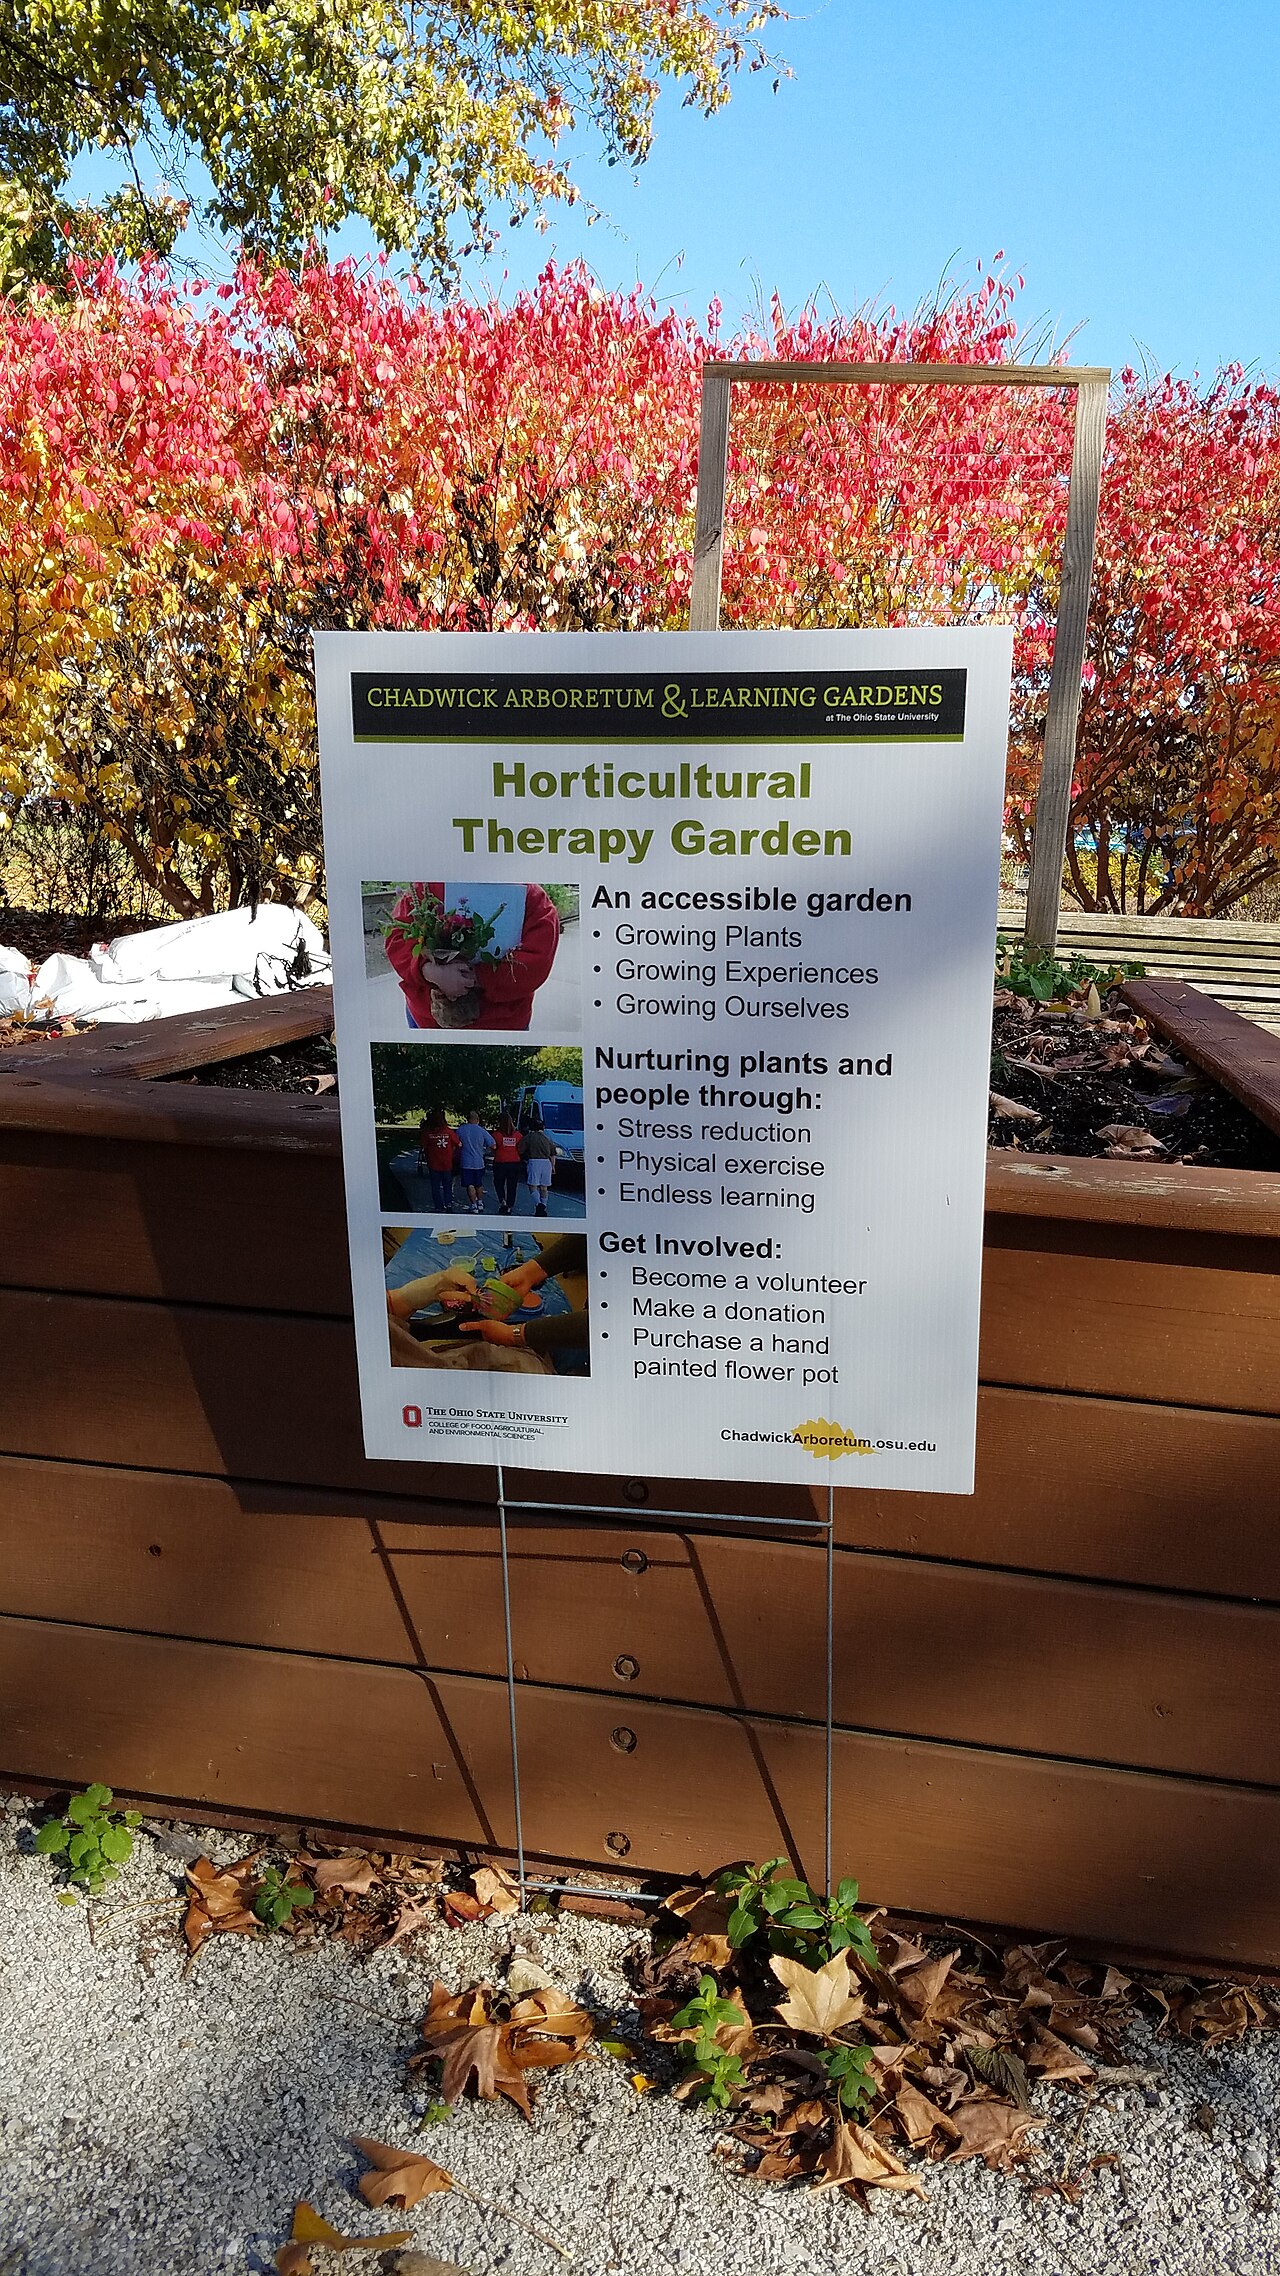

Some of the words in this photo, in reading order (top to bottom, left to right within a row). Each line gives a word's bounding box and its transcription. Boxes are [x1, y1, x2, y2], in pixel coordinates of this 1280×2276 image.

[367, 687, 498, 708] CHADWICK
[503, 688, 655, 709] ARBORETUM
[661, 683, 689, 718] &
[690, 686, 817, 709] LEARNING
[823, 684, 943, 707] GARDENS
[826, 714, 835, 722] at
[836, 713, 851, 722] The
[853, 713, 872, 722] Ohio
[874, 713, 896, 722] State
[898, 712, 940, 723] University
[492, 761, 812, 799] Horticultural
[452, 818, 654, 864] Therapy
[670, 819, 852, 857] Garden
[591, 885, 631, 909] An
[641, 886, 797, 912] accessible
[806, 888, 912, 917] garden
[615, 923, 716, 952] Growing
[725, 925, 802, 948] Plants
[615, 958, 716, 987] Growing
[725, 960, 879, 987] Experiences
[616, 993, 716, 1022] Growing
[725, 995, 850, 1019] Ourselves
[595, 1046, 730, 1077] Nurturing
[740, 1050, 829, 1077] plants
[838, 1054, 893, 1076] and
[595, 1084, 690, 1110] people
[699, 1085, 822, 1114] through:
[618, 1117, 693, 1140] Stress
[701, 1122, 811, 1143] reduction
[619, 1151, 717, 1176] Physical
[724, 1156, 825, 1177] exercise
[620, 1182, 712, 1205] Endless
[721, 1185, 815, 1214] learning
[599, 1231, 647, 1254] Get
[655, 1234, 782, 1259] Involved:
[632, 1266, 727, 1289] Become
[734, 1274, 749, 1290] a
[757, 1272, 868, 1295] volunteer
[632, 1297, 695, 1319] Make
[702, 1303, 717, 1320] a
[724, 1302, 825, 1324] donation
[633, 1327, 742, 1351] Purchase
[749, 1336, 764, 1352] a
[772, 1333, 829, 1355] hand
[633, 1358, 717, 1379] painted
[724, 1360, 795, 1382] flower
[802, 1365, 839, 1386] pot
[426, 1406, 447, 1416] THE
[449, 1407, 474, 1417] OHIO
[476, 1408, 506, 1419] STATE
[508, 1411, 569, 1423] UNIVERSITY
[428, 1421, 459, 1429] COLLEGE
[471, 1423, 493, 1431] FOOD,
[494, 1424, 545, 1435] AGRICULTURAL,
[445, 1429, 502, 1438] ENVIRONMENTAL
[502, 1432, 536, 1441] SCIENCES
[720, 1429, 936, 1452] ChadwickArboretum.osu.edu
